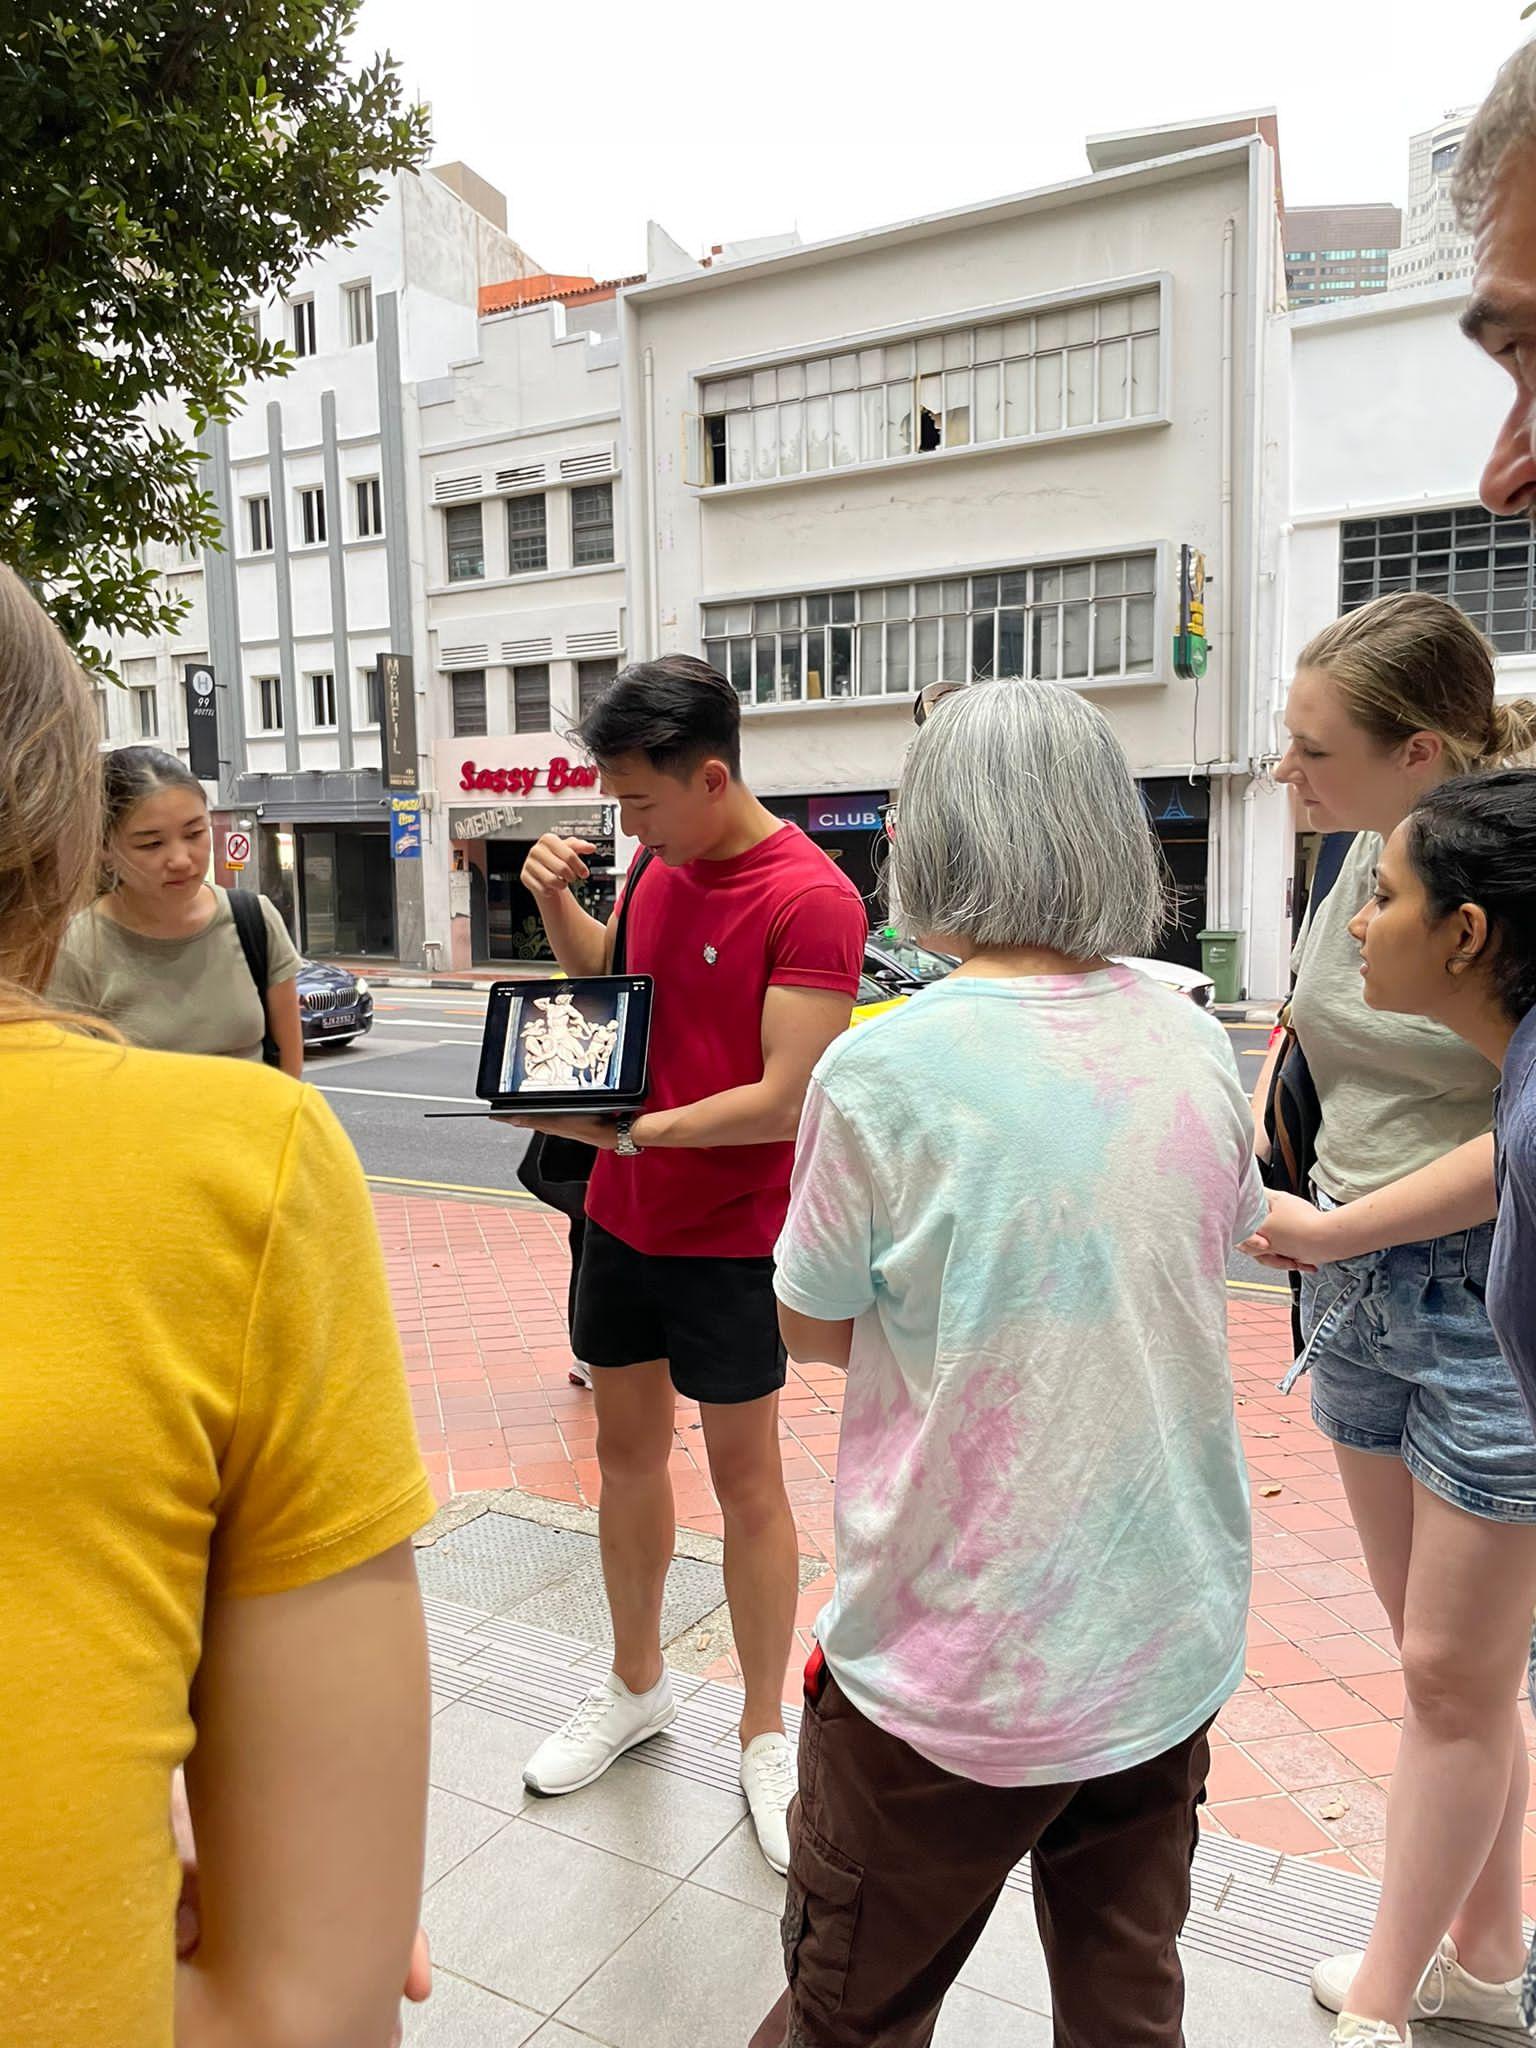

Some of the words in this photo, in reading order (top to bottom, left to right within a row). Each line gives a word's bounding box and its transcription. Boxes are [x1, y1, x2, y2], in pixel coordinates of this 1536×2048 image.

[198, 697, 210, 707] 99
[387, 658, 401, 754] MEHFIL
[459, 760, 539, 796] Sassy
[547, 757, 599, 793] Bar
[455, 806, 523, 839] MEHFIL
[819, 812, 877, 827] CLUB
